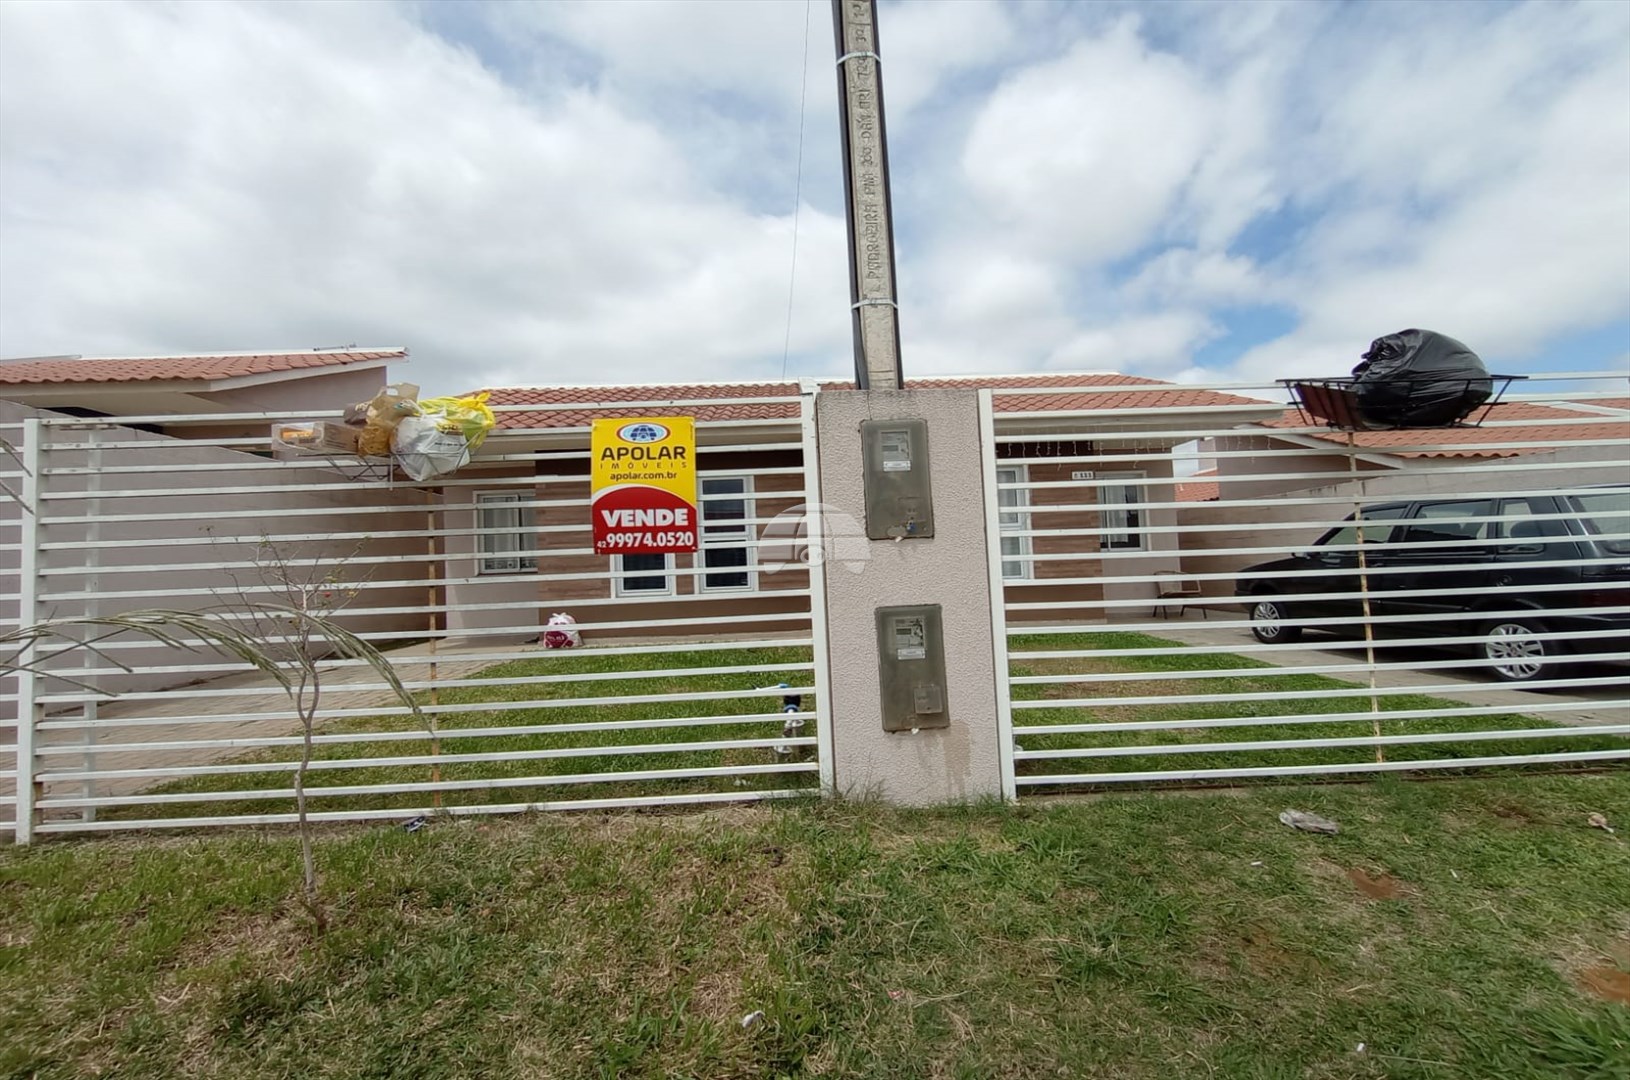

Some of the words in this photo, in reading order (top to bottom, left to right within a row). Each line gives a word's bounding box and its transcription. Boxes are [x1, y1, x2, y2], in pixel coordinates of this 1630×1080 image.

[601, 446, 686, 461] APOLAR
[610, 471, 677, 481] apolar.com.br
[601, 508, 689, 527] VENDE
[606, 531, 694, 548] 99974.0520
